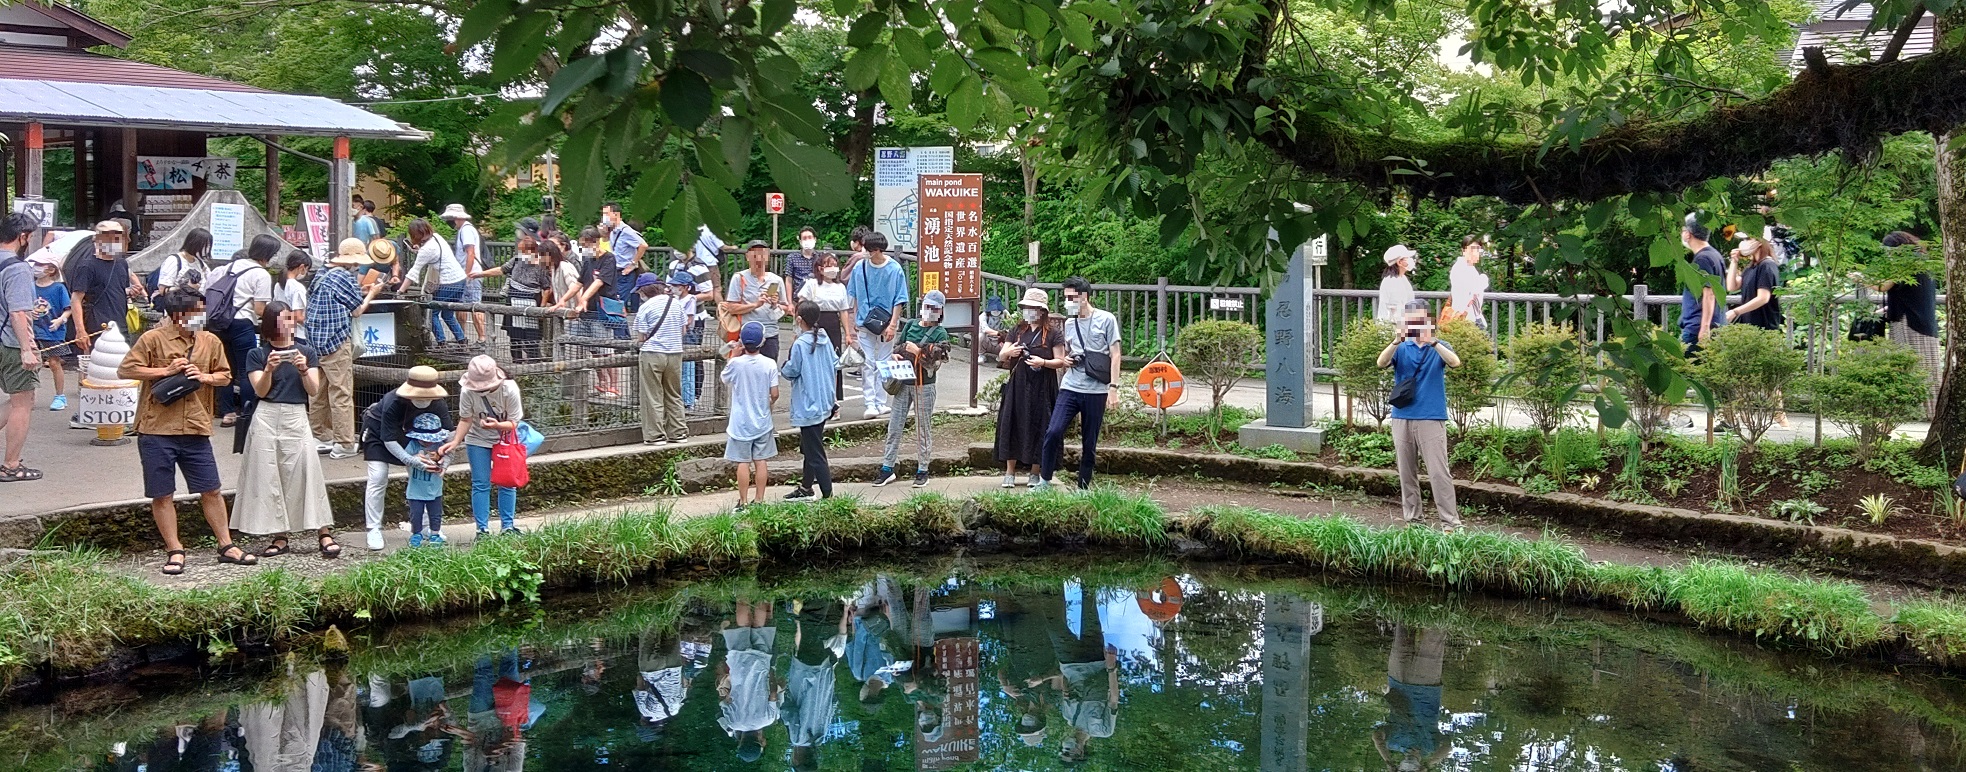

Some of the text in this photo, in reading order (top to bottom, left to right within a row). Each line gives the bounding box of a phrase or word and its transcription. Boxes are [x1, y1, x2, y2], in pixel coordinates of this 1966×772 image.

[925, 188, 978, 197] WAKUIKE
[944, 179, 962, 187] pond
[924, 217, 940, 263] 湧池
[943, 210, 954, 269] 国指定天然記念物
[955, 210, 966, 268] 世界遺産
[967, 210, 978, 268] 名水百選
[1273, 301, 1297, 406] 忍野八海
[81, 394, 113, 404] ペットは
[83, 410, 134, 423] STOP
